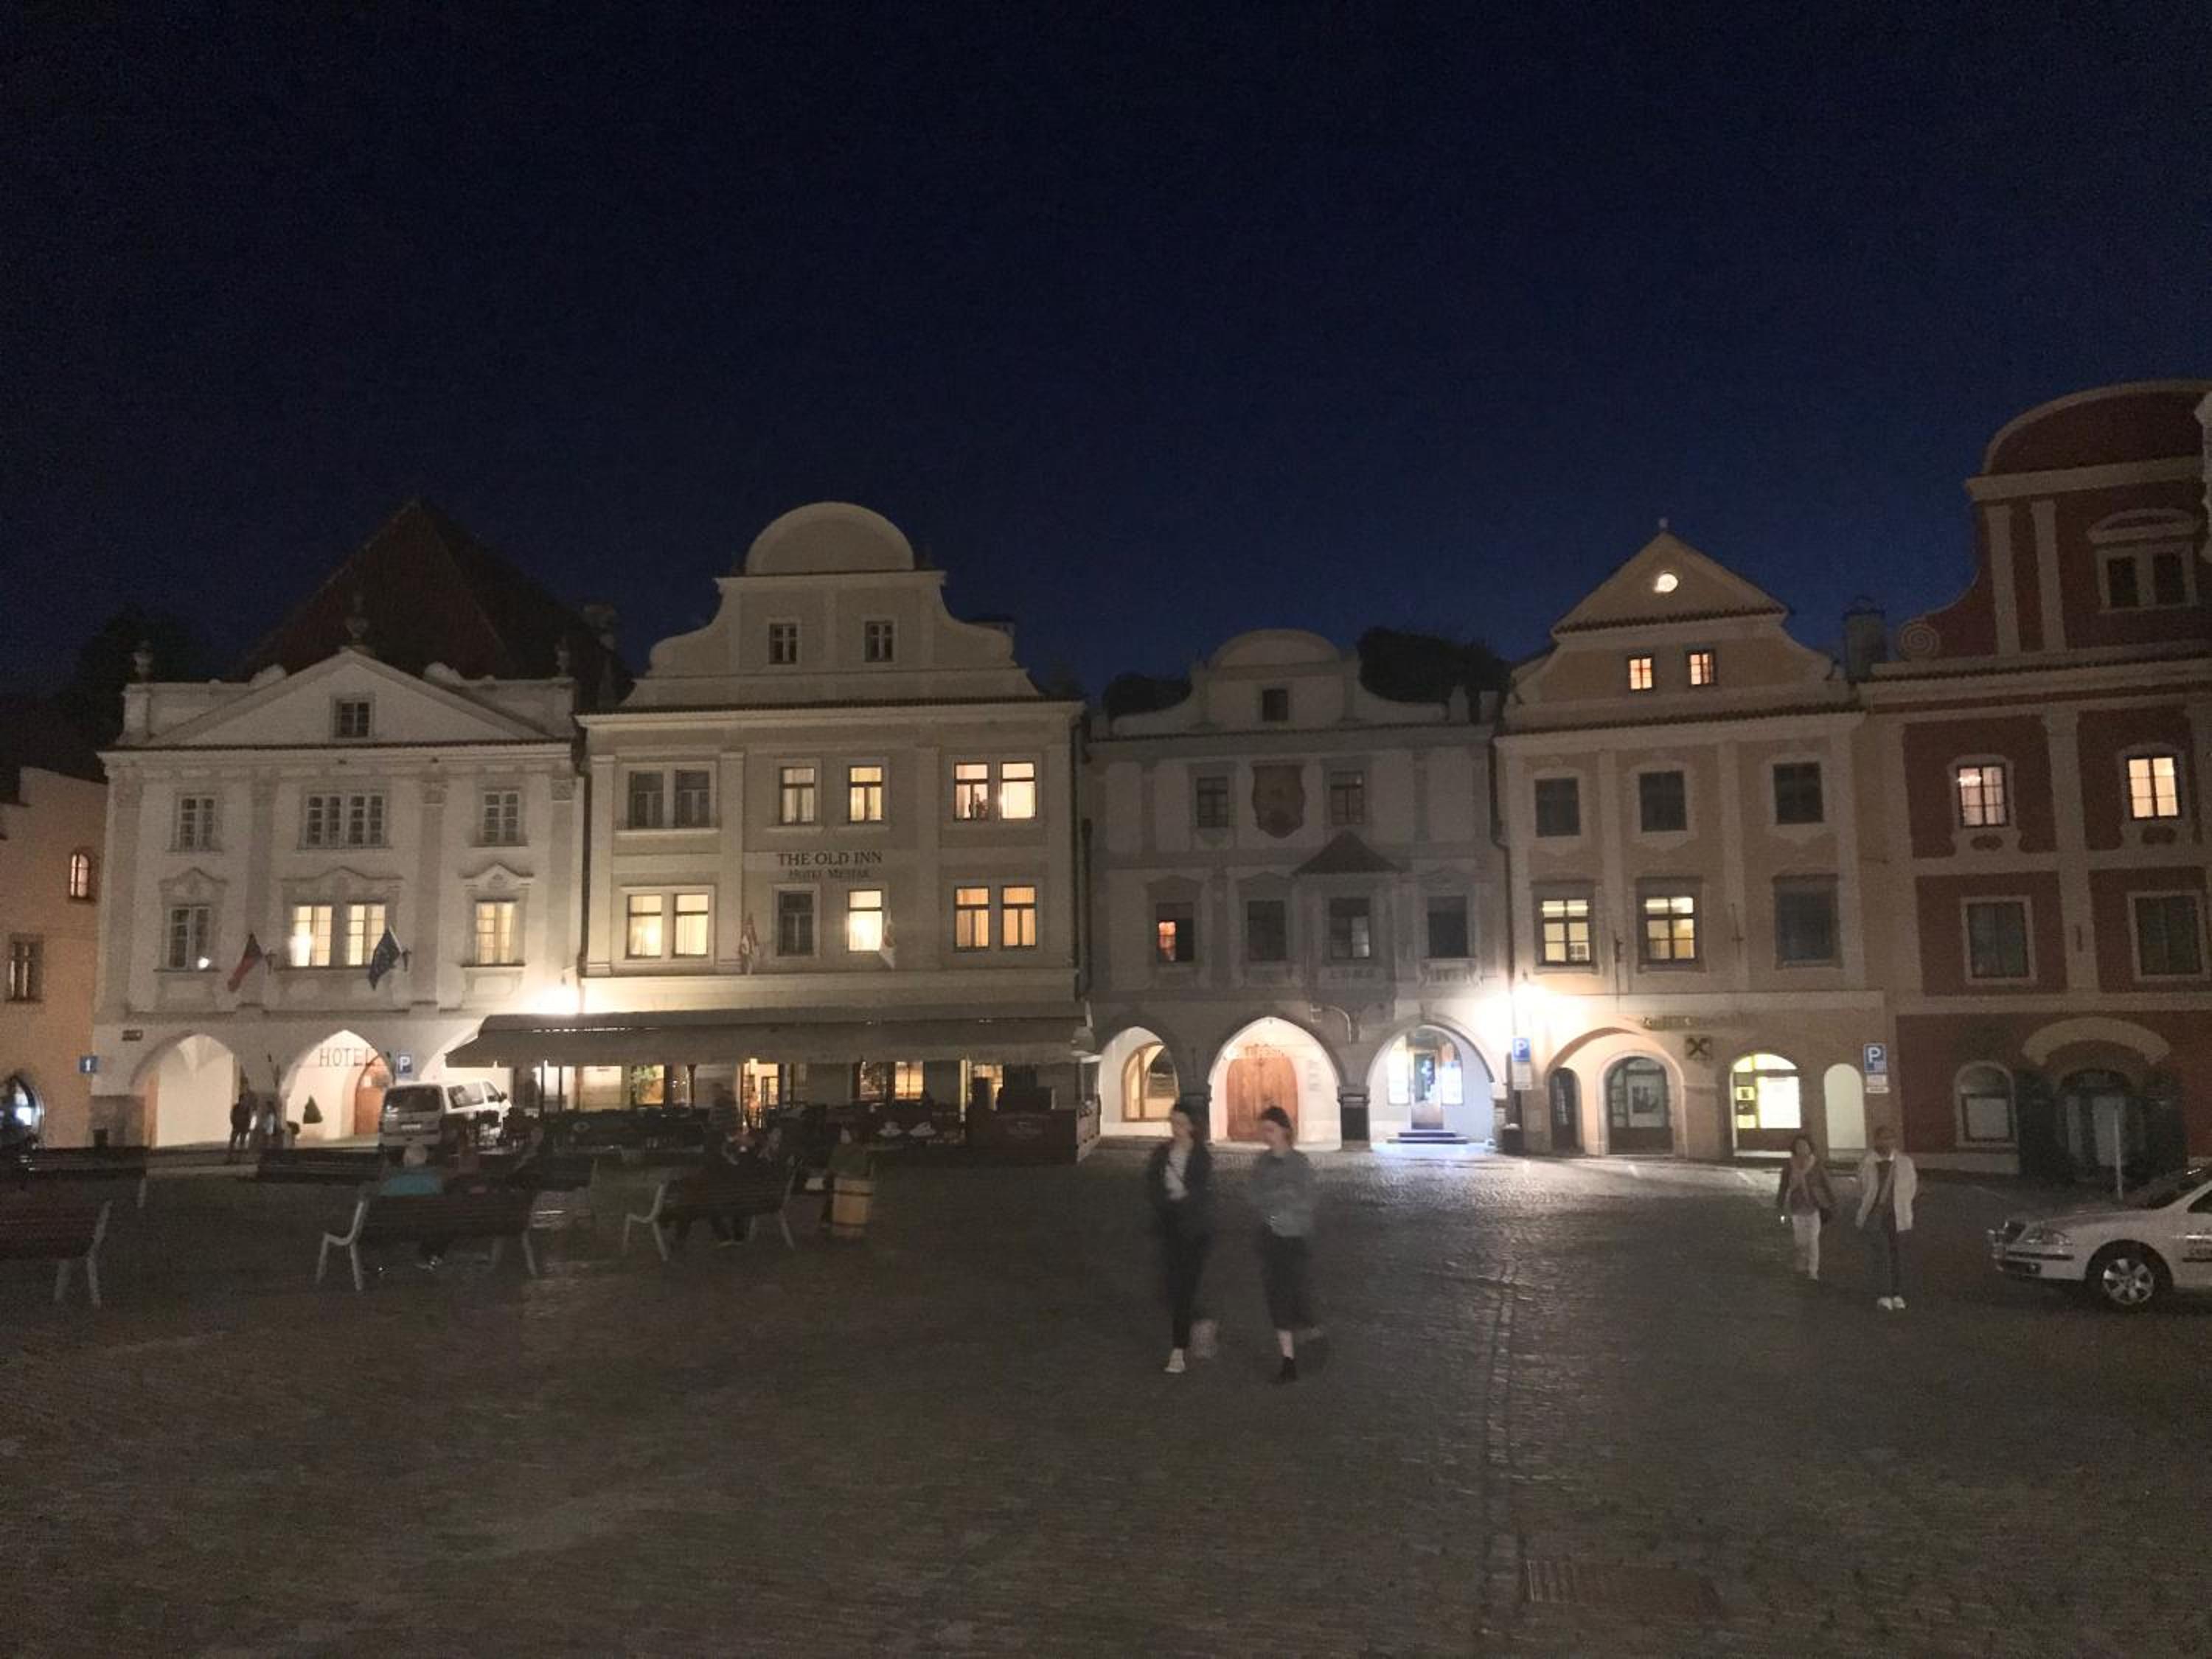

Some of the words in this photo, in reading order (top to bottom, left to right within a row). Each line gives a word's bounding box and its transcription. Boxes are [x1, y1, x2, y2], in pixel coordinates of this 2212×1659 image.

[778, 852, 810, 866] THE
[815, 852, 849, 866] OLD
[854, 850, 883, 865] INN
[1514, 1040, 1528, 1057] P
[1868, 1046, 1882, 1063] P
[319, 1047, 375, 1068] HOTEL
[399, 1055, 411, 1072] P
